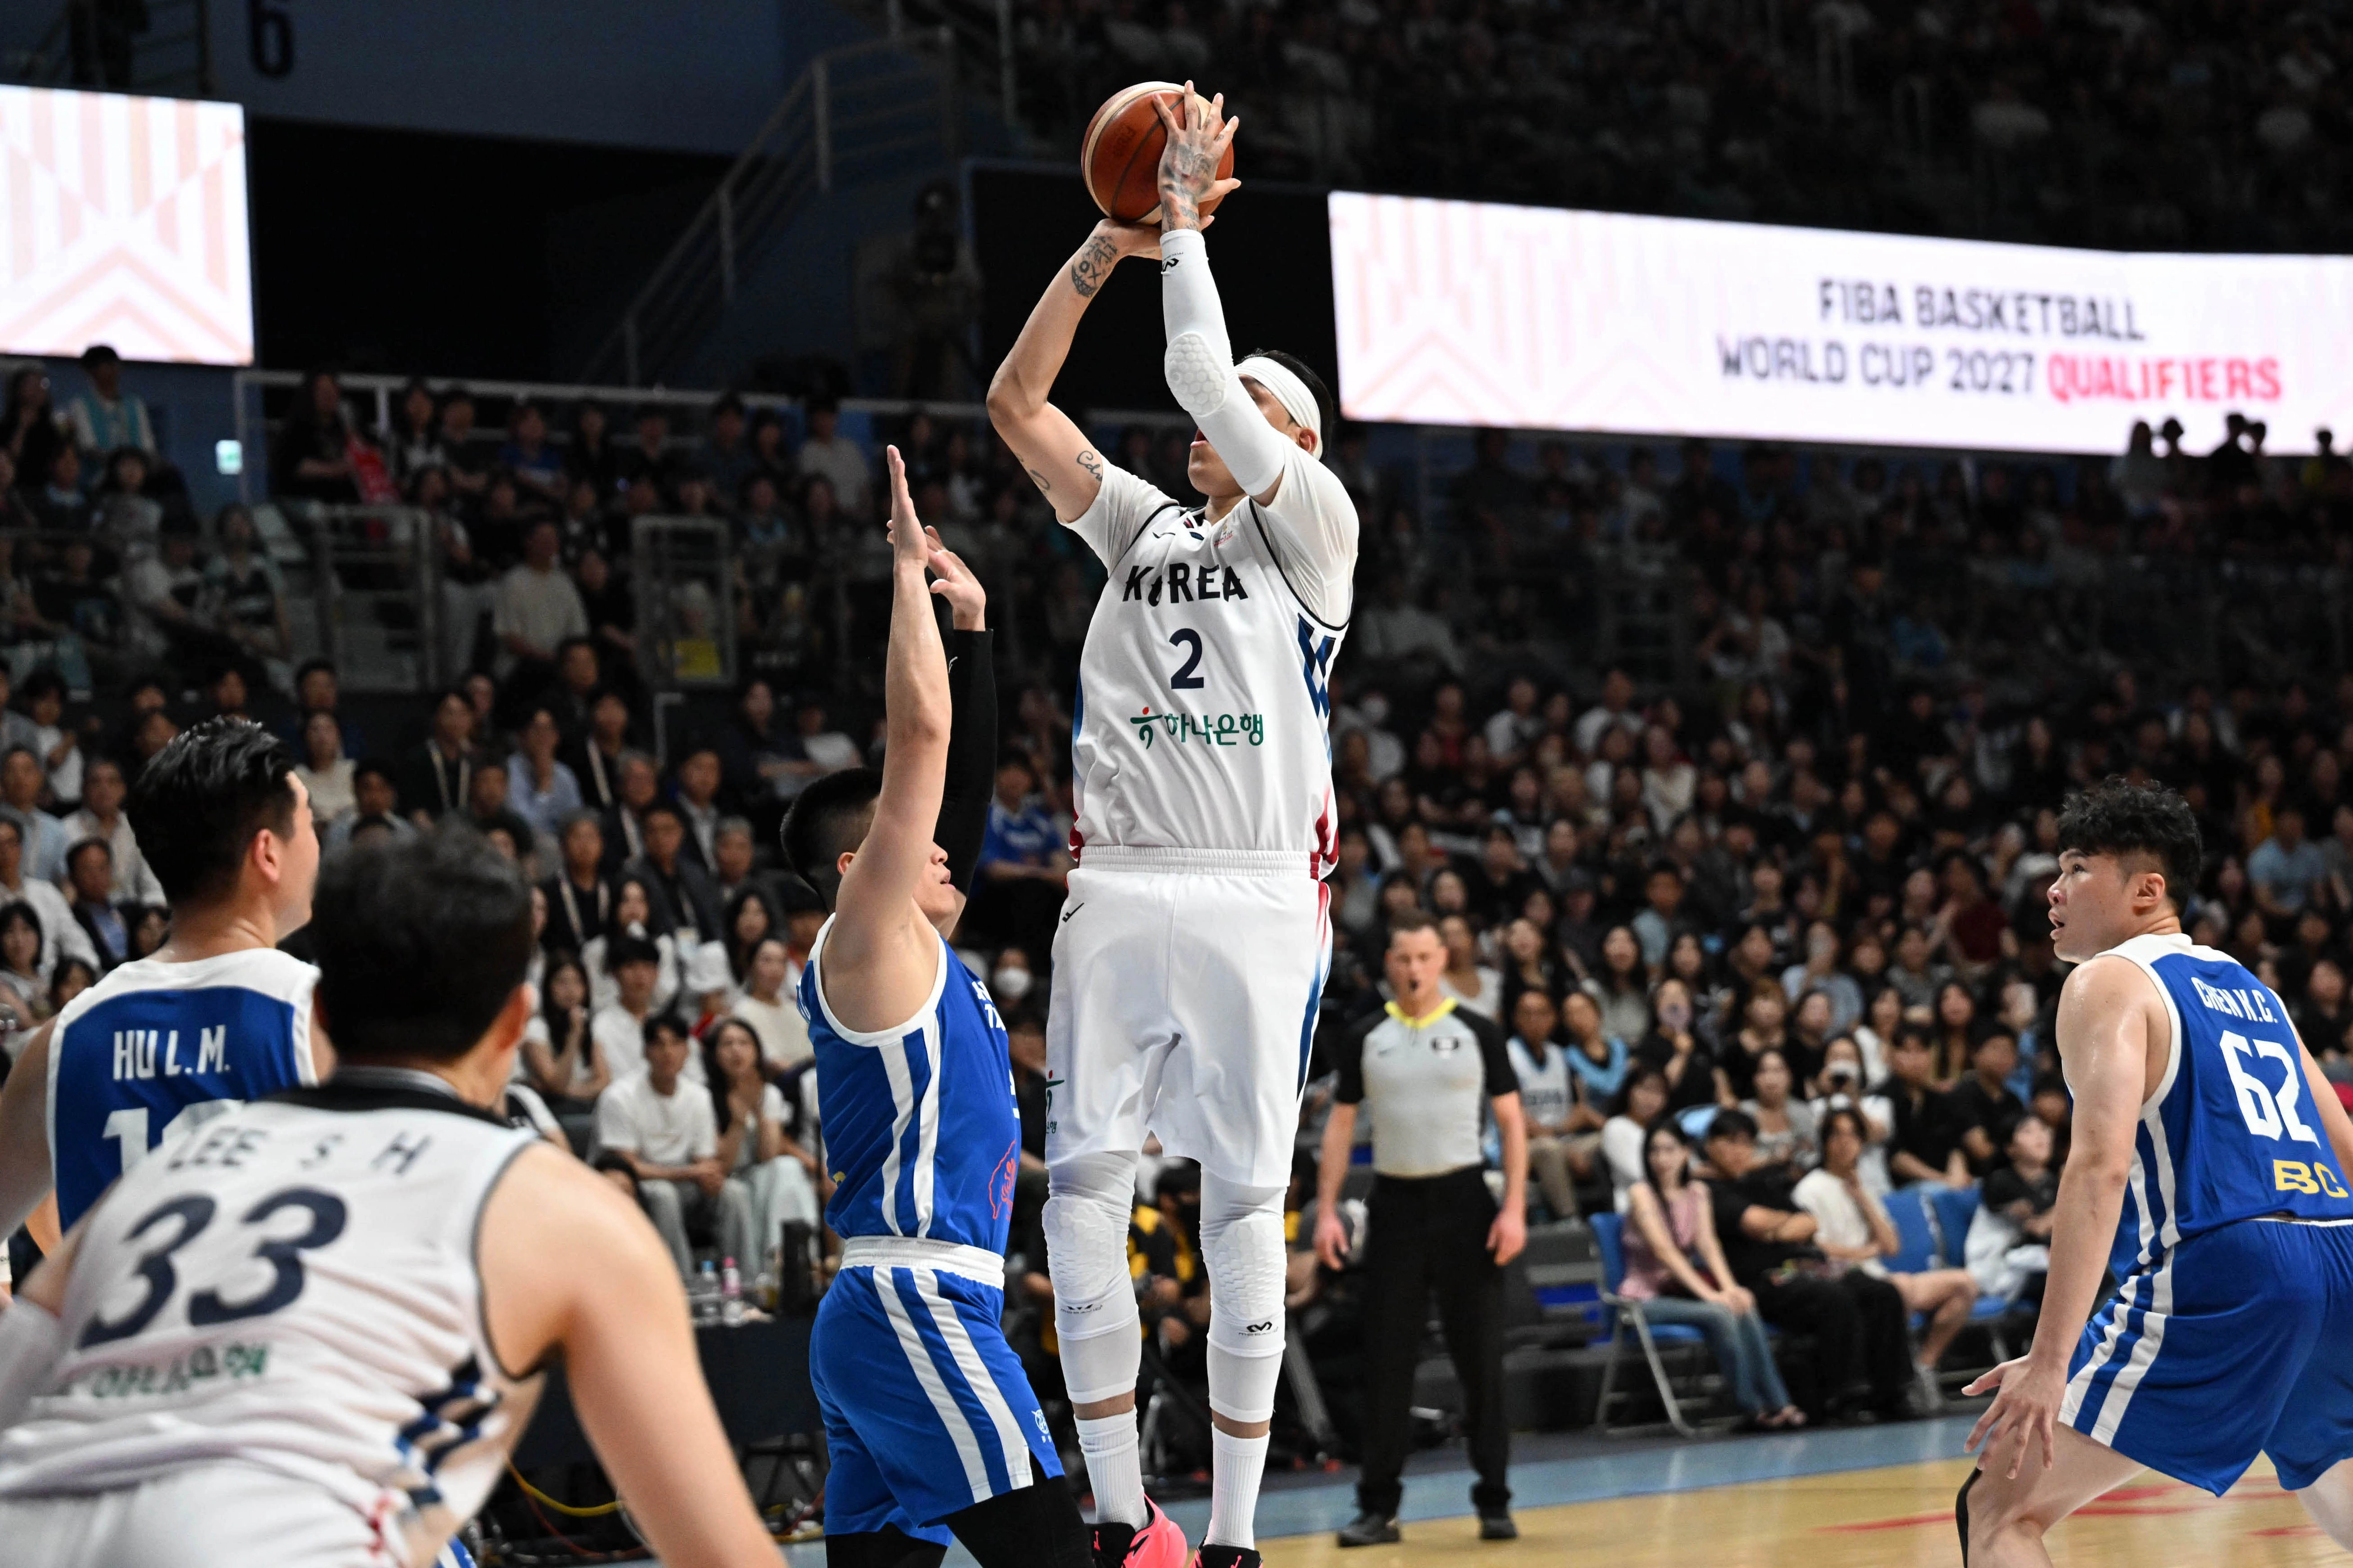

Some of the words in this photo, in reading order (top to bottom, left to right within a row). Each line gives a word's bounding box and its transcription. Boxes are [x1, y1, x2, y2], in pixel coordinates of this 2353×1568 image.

[1819, 279, 1901, 323] FIBA
[1915, 286, 2145, 342] BASKETBALL
[1718, 334, 1846, 384] WORLD
[1861, 343, 1934, 386] CUP
[1946, 349, 2034, 392] 2027
[2048, 354, 2282, 403] QUALIFIERS
[1122, 562, 1249, 607] KOREA
[1169, 628, 1205, 690] 2
[1164, 713, 1264, 746] 하나은행
[2191, 977, 2244, 1019] CHEN
[2232, 989, 2278, 1023] K.C.
[113, 1029, 158, 1080] HU
[165, 1025, 231, 1076] L.M.
[2219, 1030, 2321, 1150] 62
[167, 1126, 268, 1170] LEE
[299, 1135, 344, 1170] S
[370, 1131, 432, 1176] H
[2273, 1159, 2349, 1198] BC
[76, 1184, 348, 1351] 33
